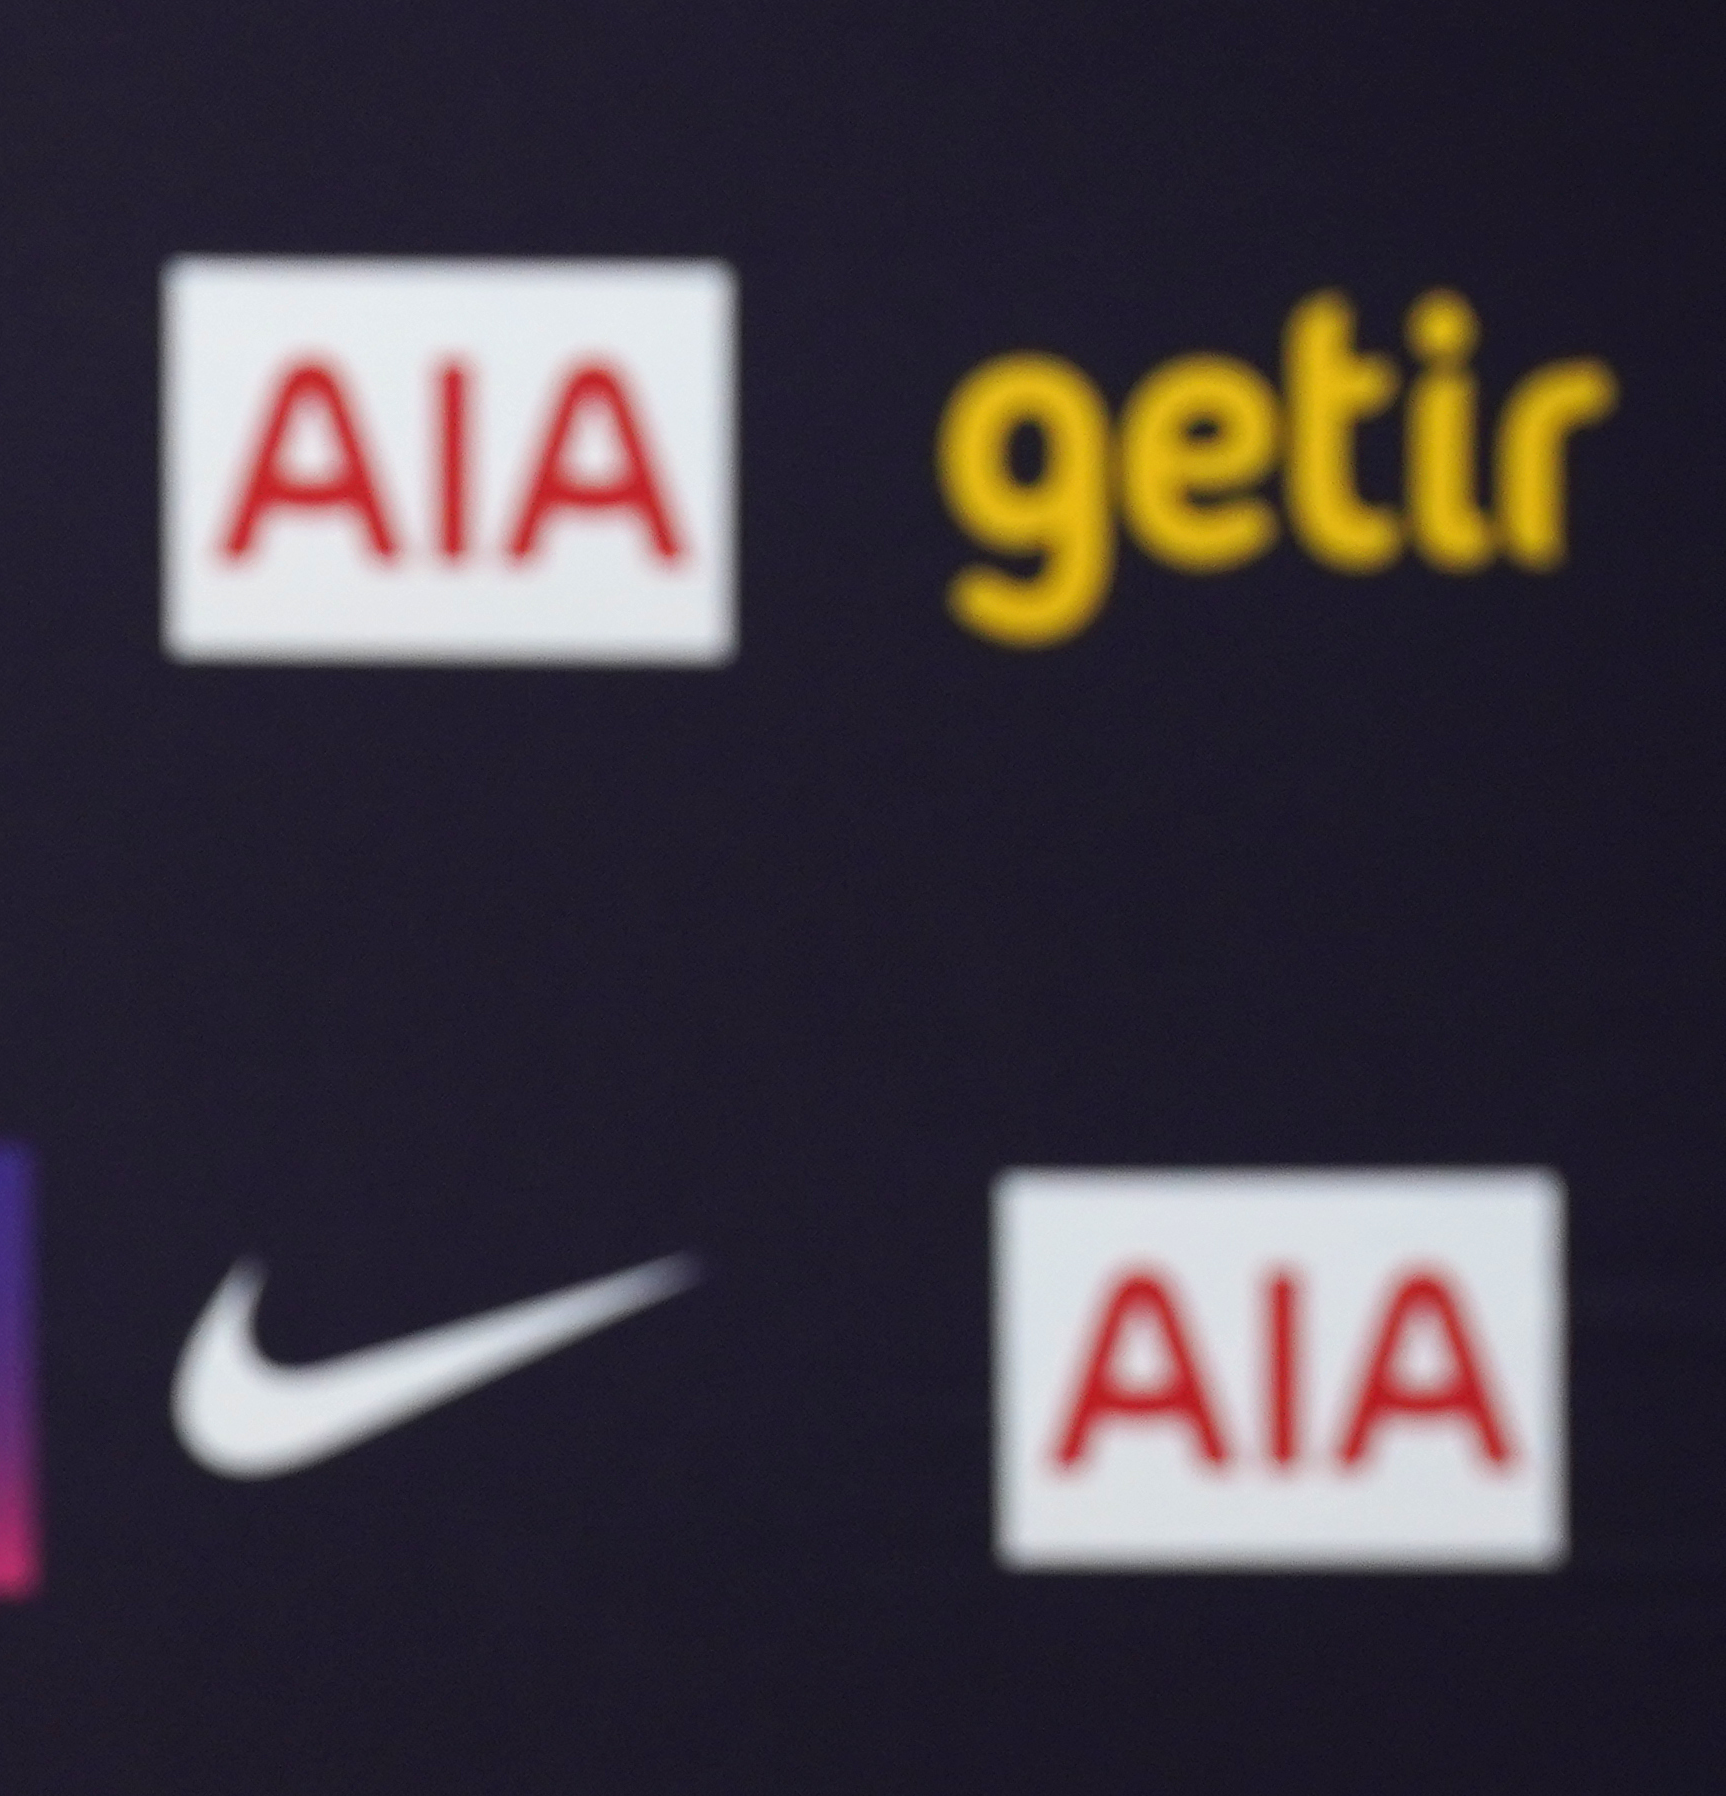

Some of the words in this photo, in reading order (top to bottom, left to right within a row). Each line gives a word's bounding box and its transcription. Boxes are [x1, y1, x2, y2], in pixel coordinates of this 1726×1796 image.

[216, 354, 687, 569] AIA
[937, 290, 1617, 648] getir
[1048, 1266, 1517, 1474] AIA
